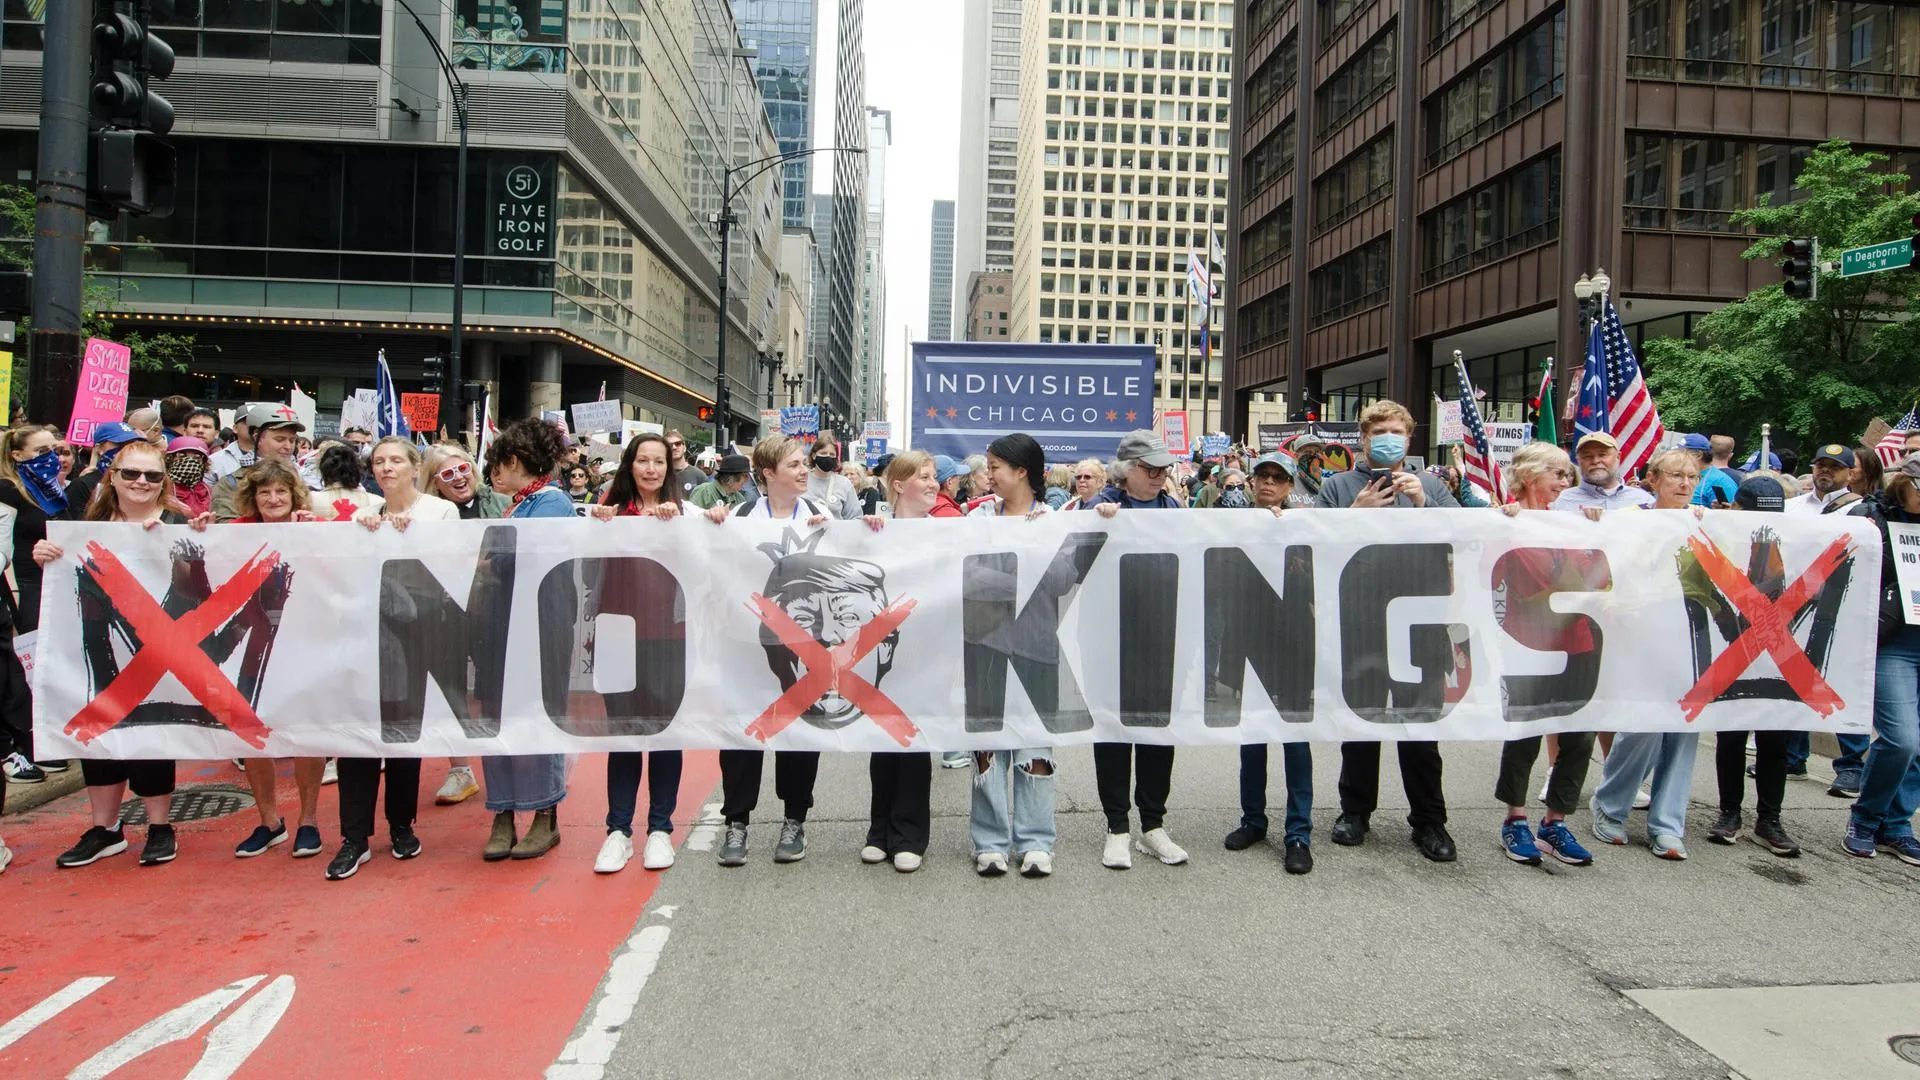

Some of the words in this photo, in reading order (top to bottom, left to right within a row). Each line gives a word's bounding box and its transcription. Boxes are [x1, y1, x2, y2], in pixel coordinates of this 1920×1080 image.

[499, 203, 546, 217] FIVE
[498, 219, 545, 233] IRON
[498, 238, 545, 251] GOLF
[1855, 247, 1897, 262] Dearborn
[1901, 244, 1908, 253] St
[1868, 261, 1876, 269] 36
[88, 371, 128, 398] DICK
[925, 373, 1141, 397] INDIVISIBLE
[93, 396, 122, 412] TATOR
[967, 405, 1098, 424] CHICAGO
[1495, 427, 1523, 440] KINGS
[1493, 444, 1519, 453] DICTATO
[1899, 534, 1920, 546] AME
[1902, 552, 1917, 564] NO
[380, 526, 686, 743] NO
[962, 531, 1613, 735] KINGS
